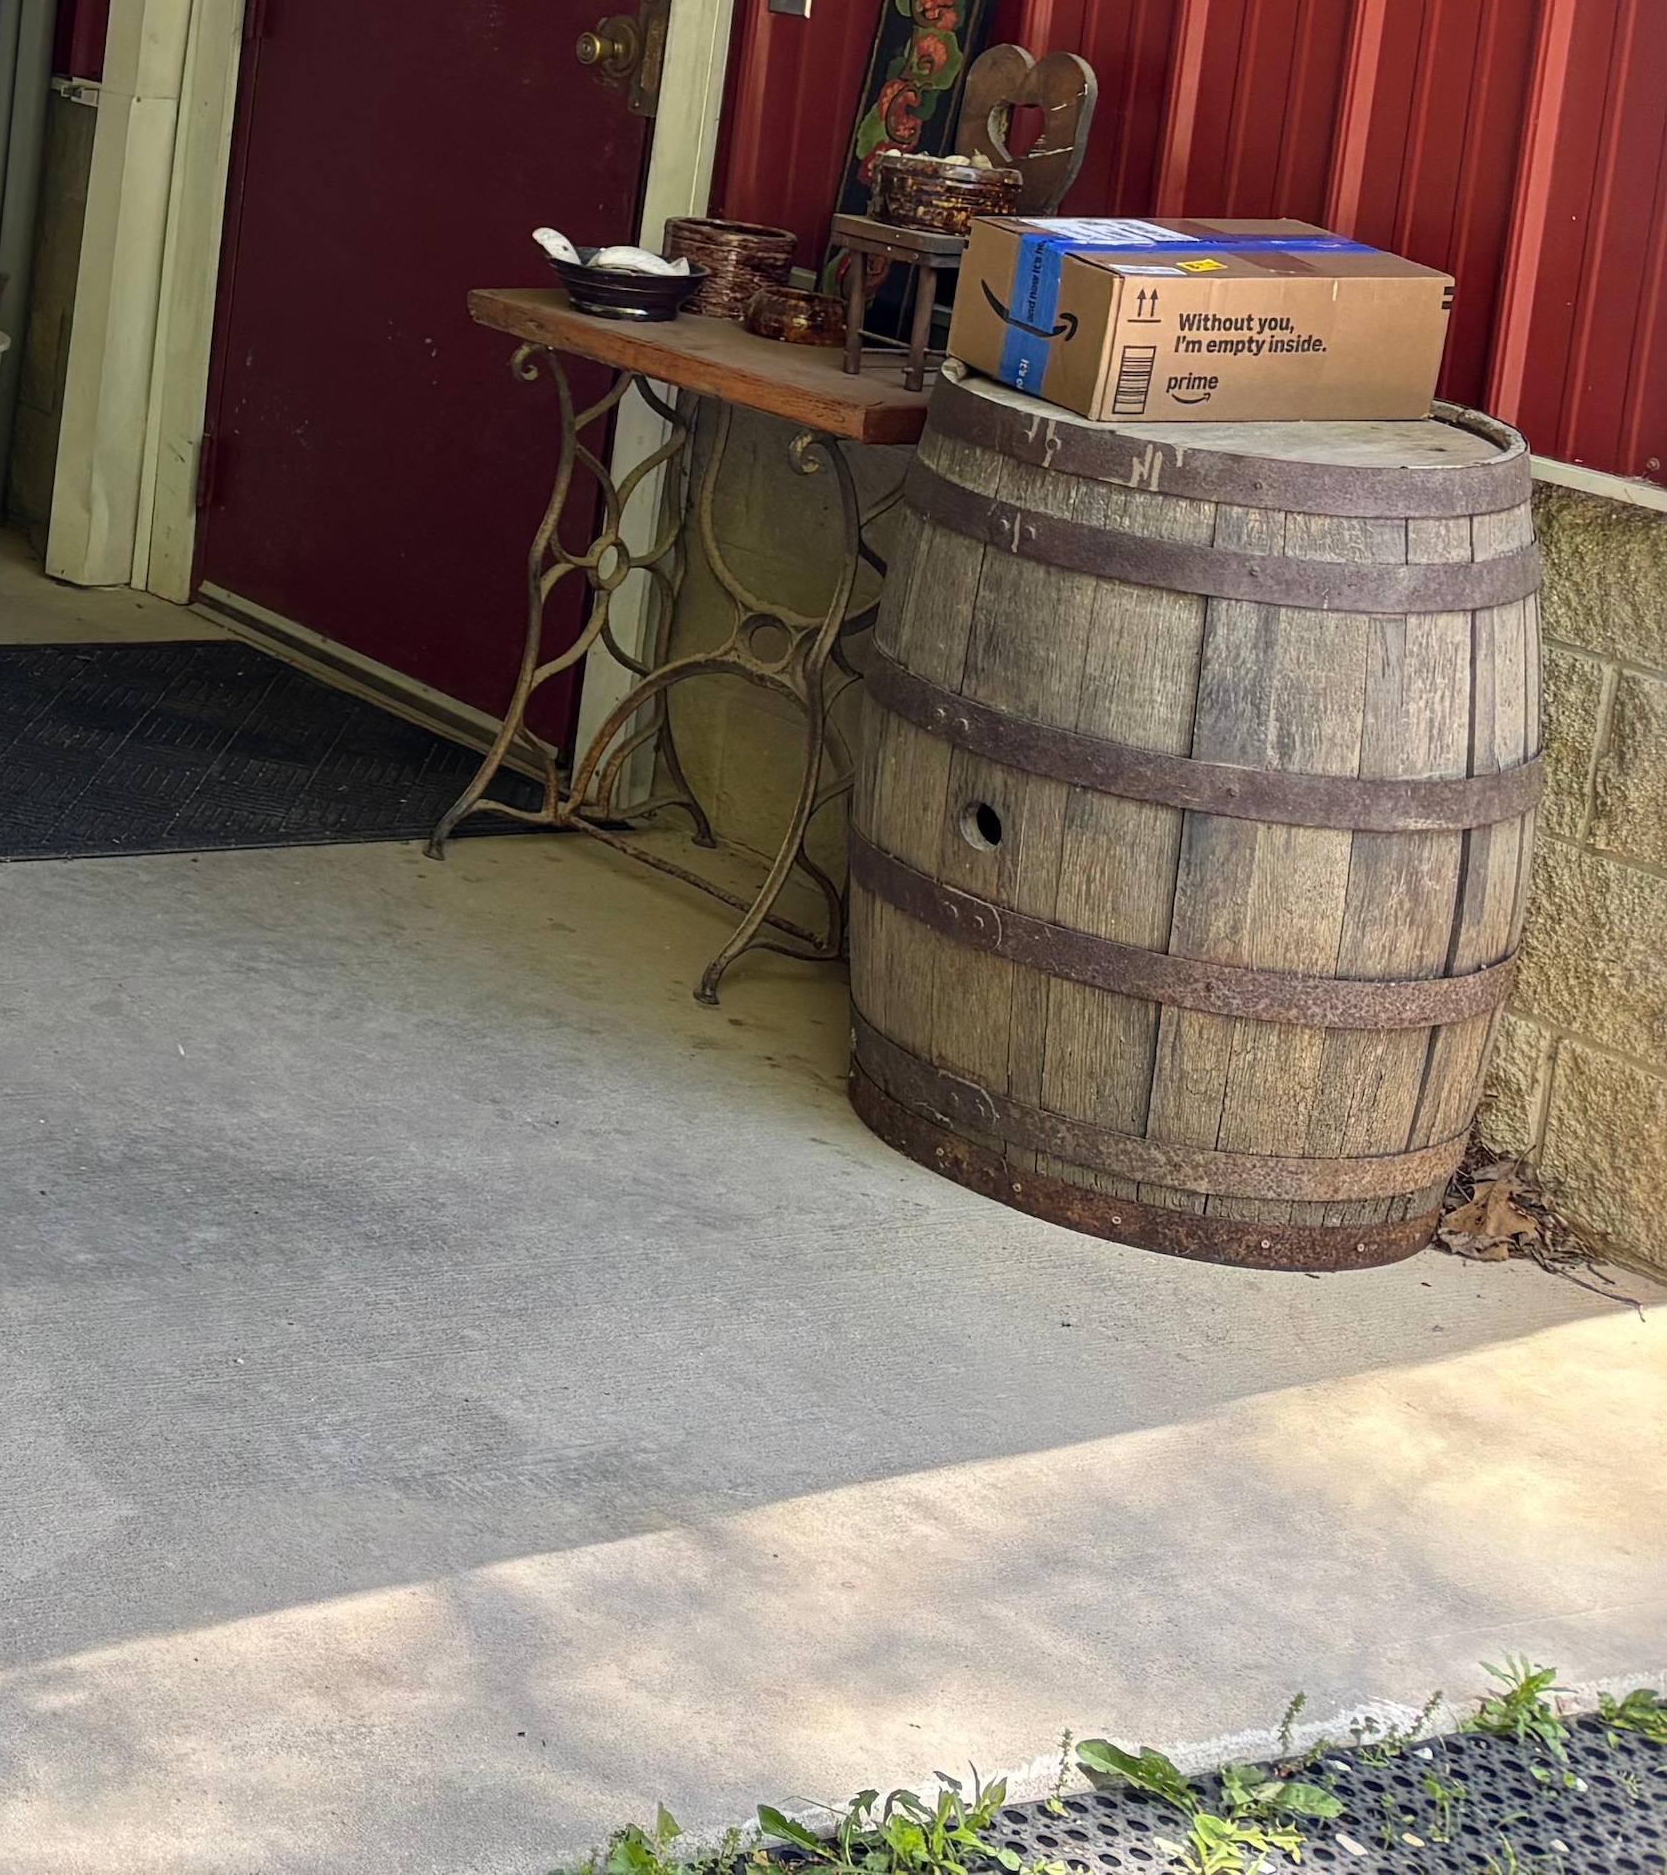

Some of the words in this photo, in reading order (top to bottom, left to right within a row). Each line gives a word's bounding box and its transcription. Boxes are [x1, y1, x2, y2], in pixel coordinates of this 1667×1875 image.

[1179, 313, 1255, 332] Without
[1256, 317, 1295, 335] you,
[1174, 335, 1203, 354] I'm
[1206, 335, 1266, 357] empty
[1268, 334, 1327, 354] inside.
[1165, 371, 1220, 394] prime
